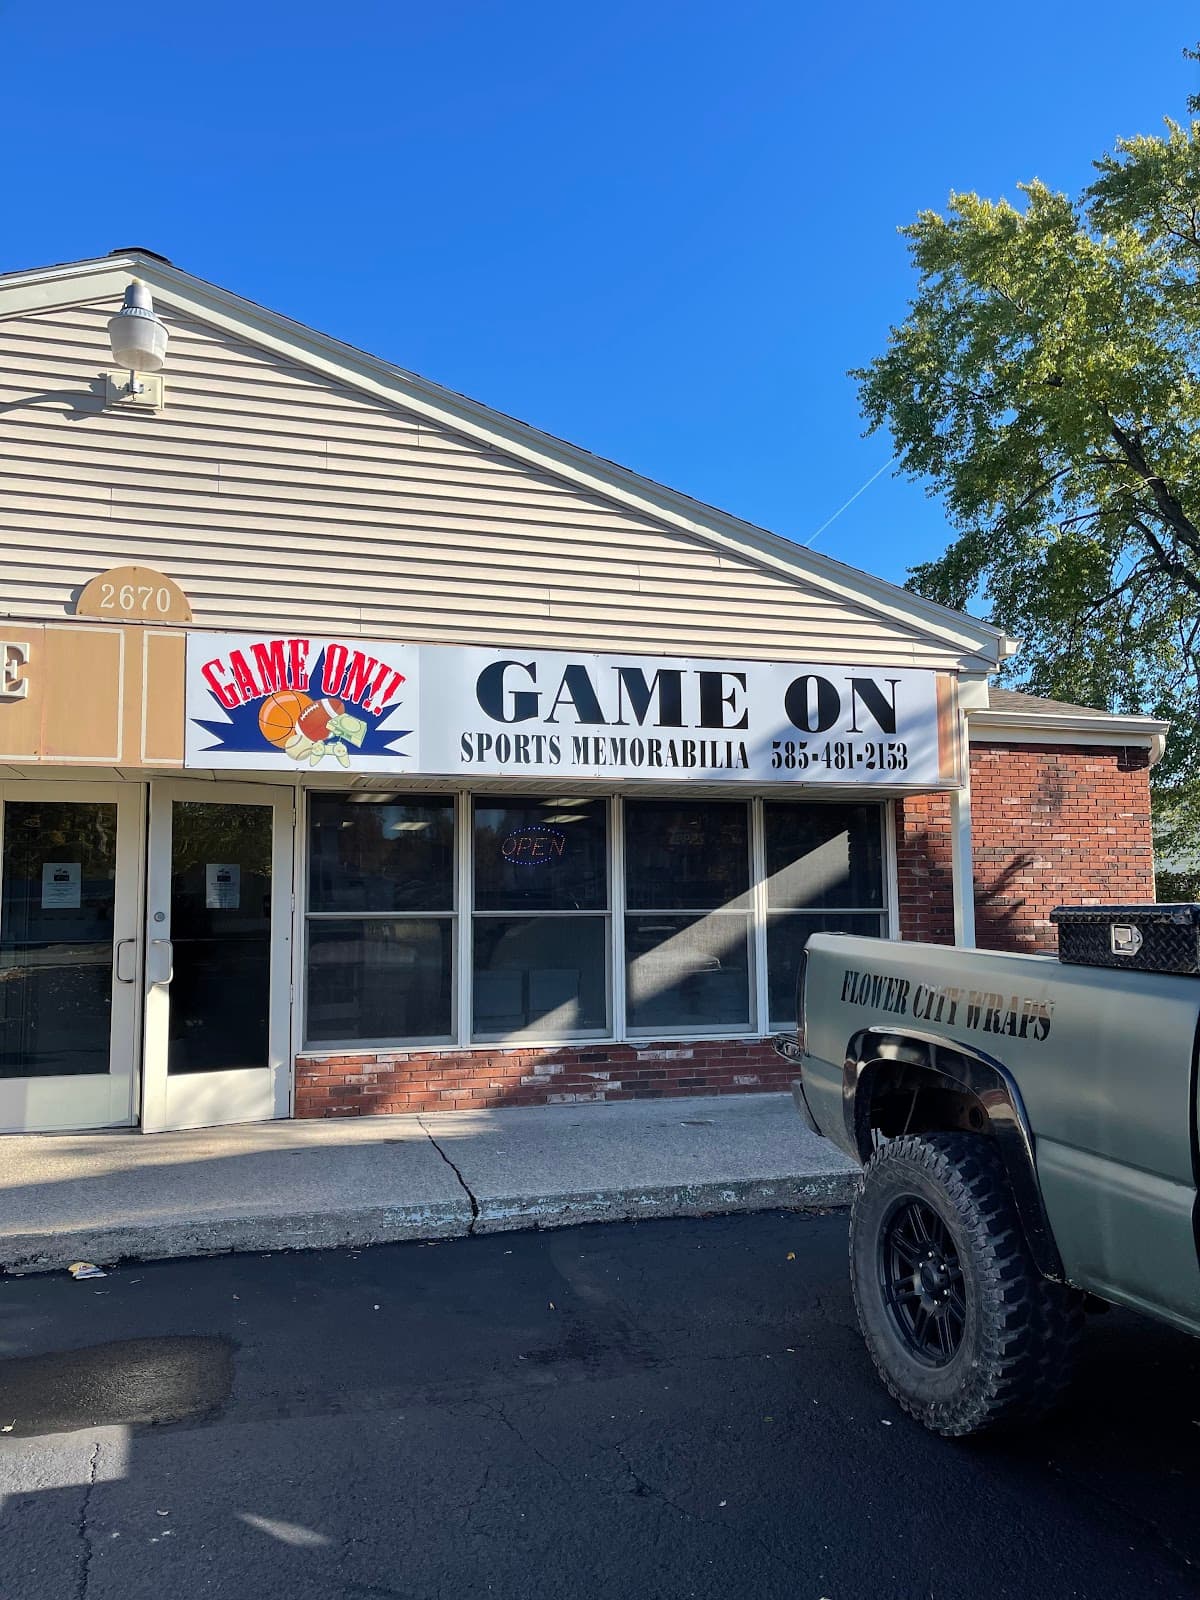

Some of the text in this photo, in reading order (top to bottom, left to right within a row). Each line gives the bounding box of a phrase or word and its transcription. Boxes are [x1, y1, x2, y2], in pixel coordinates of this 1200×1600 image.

[100, 584, 171, 613] 2670
[201, 639, 406, 717] GAME ON!!
[476, 660, 901, 734] GAME ON
[460, 731, 750, 769] SPORTS MEMORABILIA
[771, 740, 908, 771] 585-481-2153
[502, 837, 566, 856] OPEN
[841, 970, 1054, 1042] FLOWER CITY WRAPS
